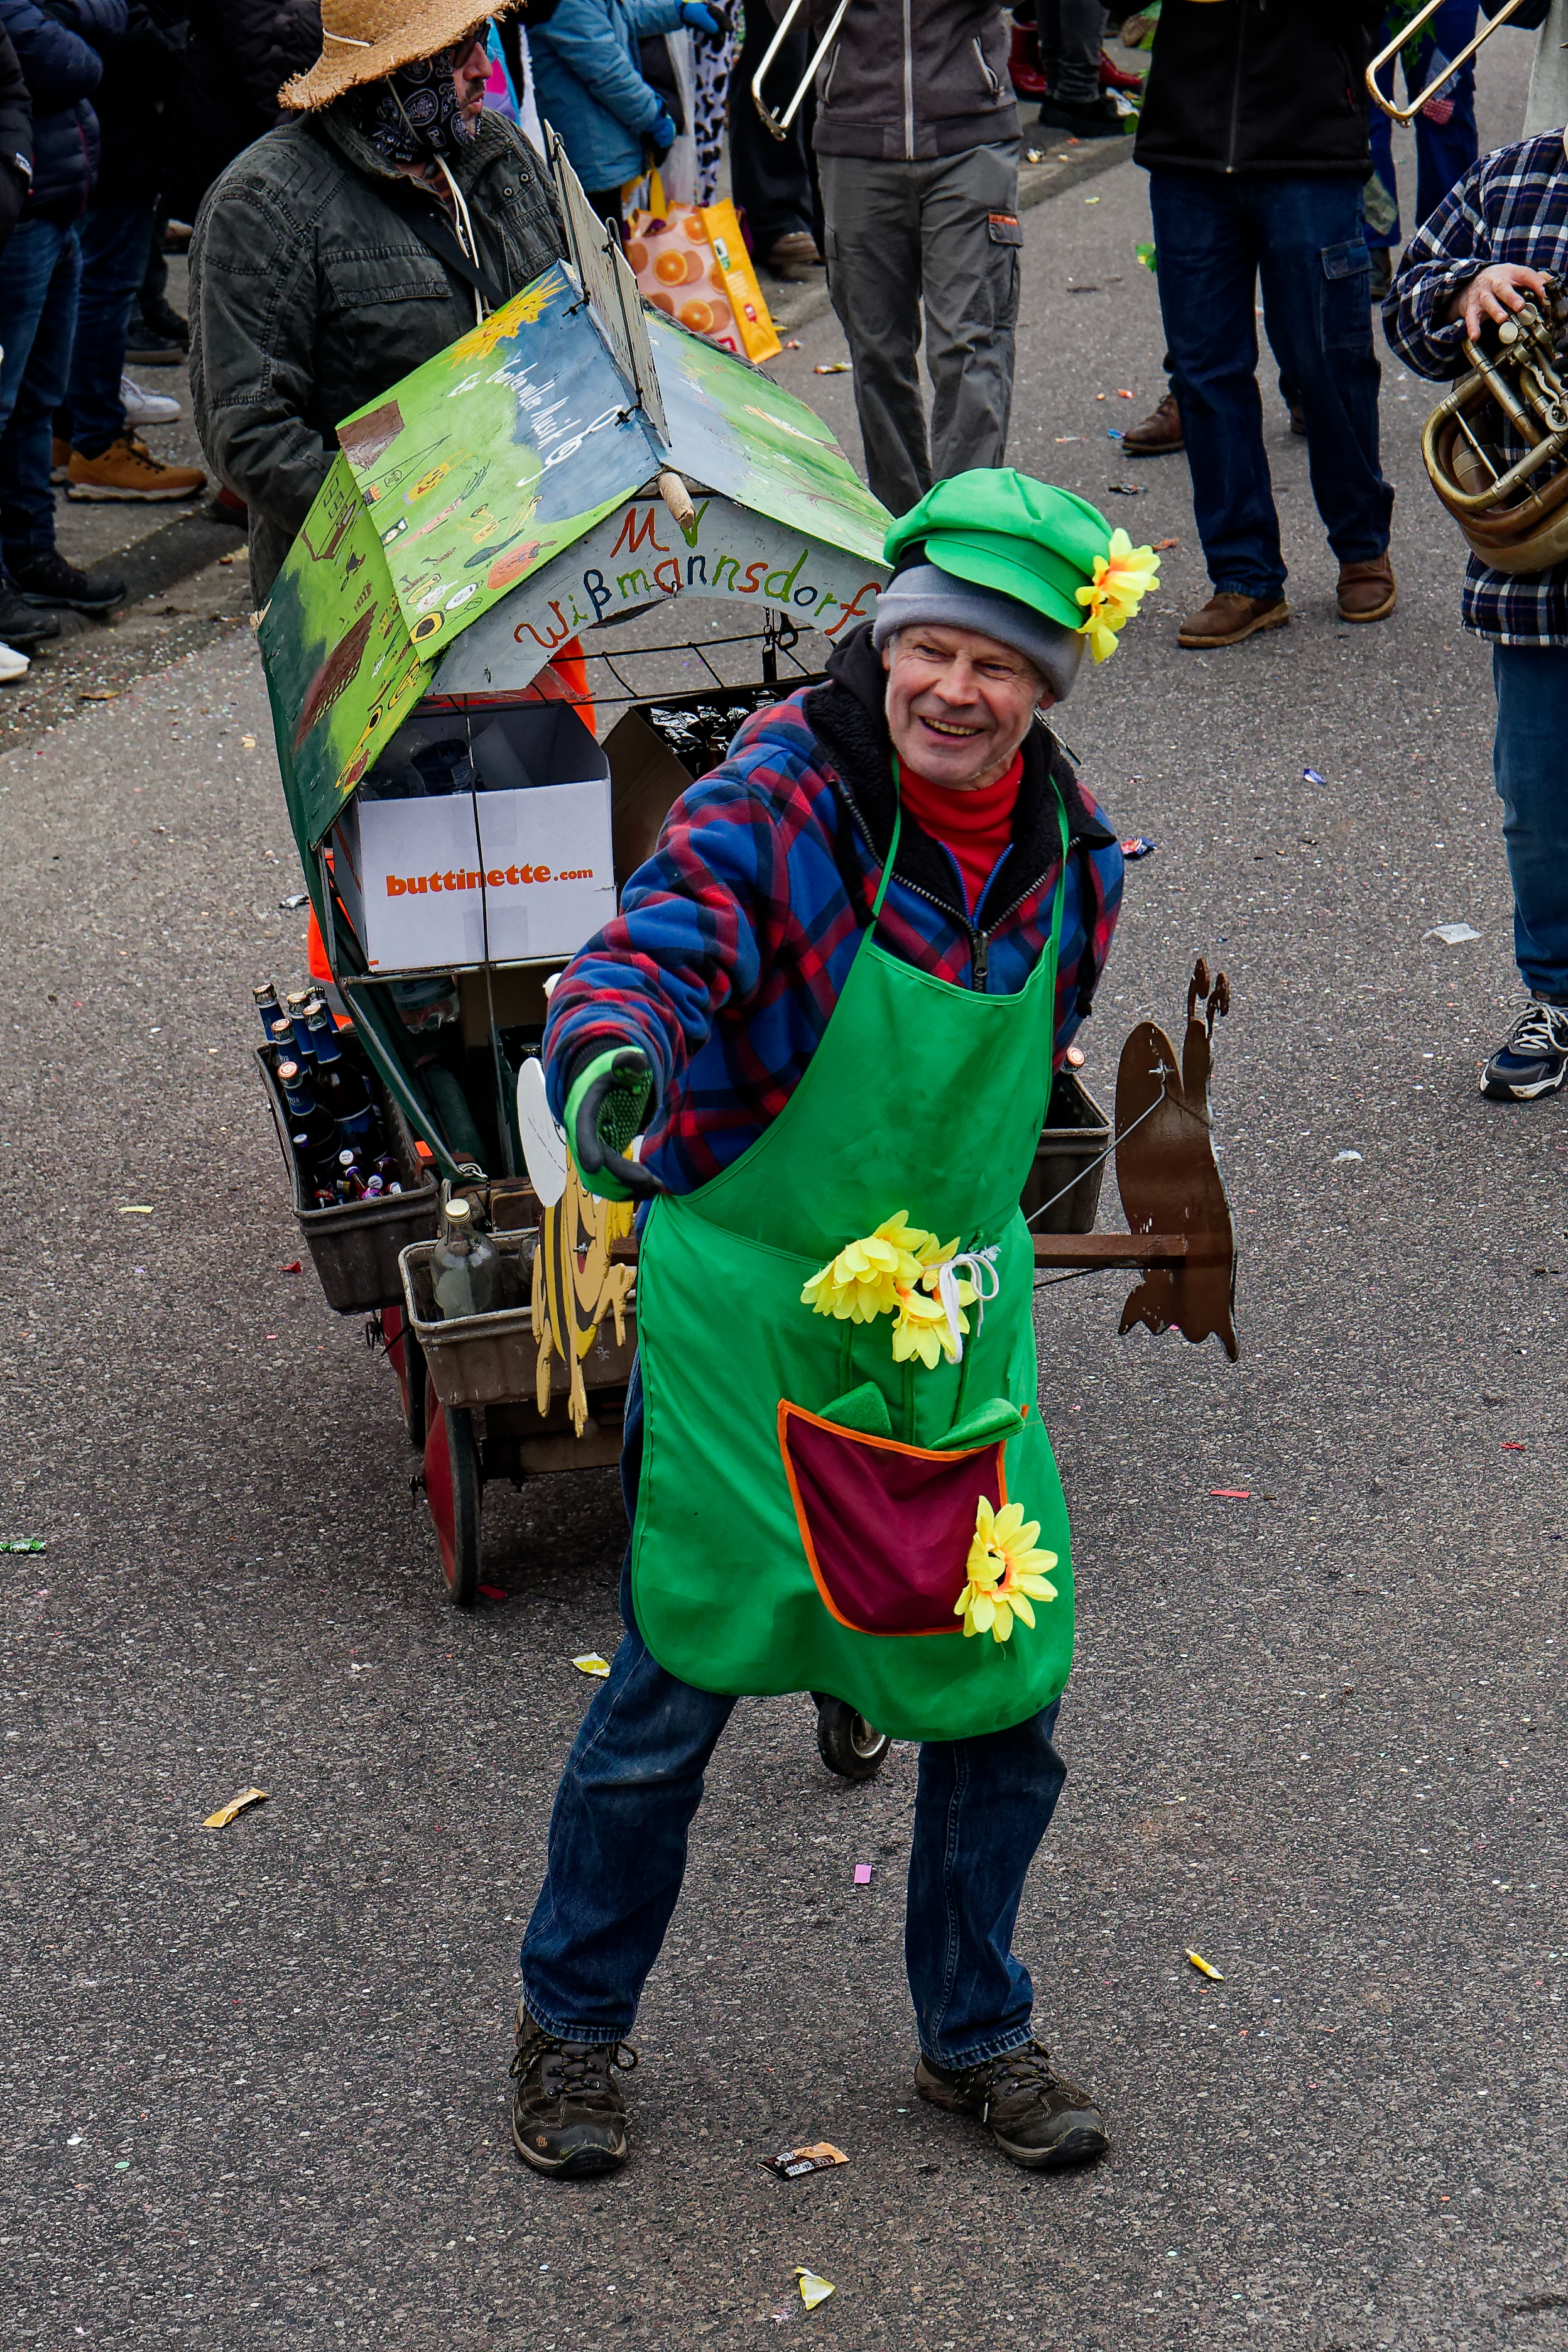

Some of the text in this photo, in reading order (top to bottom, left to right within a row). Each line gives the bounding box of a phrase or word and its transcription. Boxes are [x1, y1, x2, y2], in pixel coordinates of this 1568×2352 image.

[447, 371, 481, 397] Ein
[486, 357, 538, 391] Garten
[530, 396, 582, 450] Musik
[514, 548, 883, 649] Wißmannsdorf
